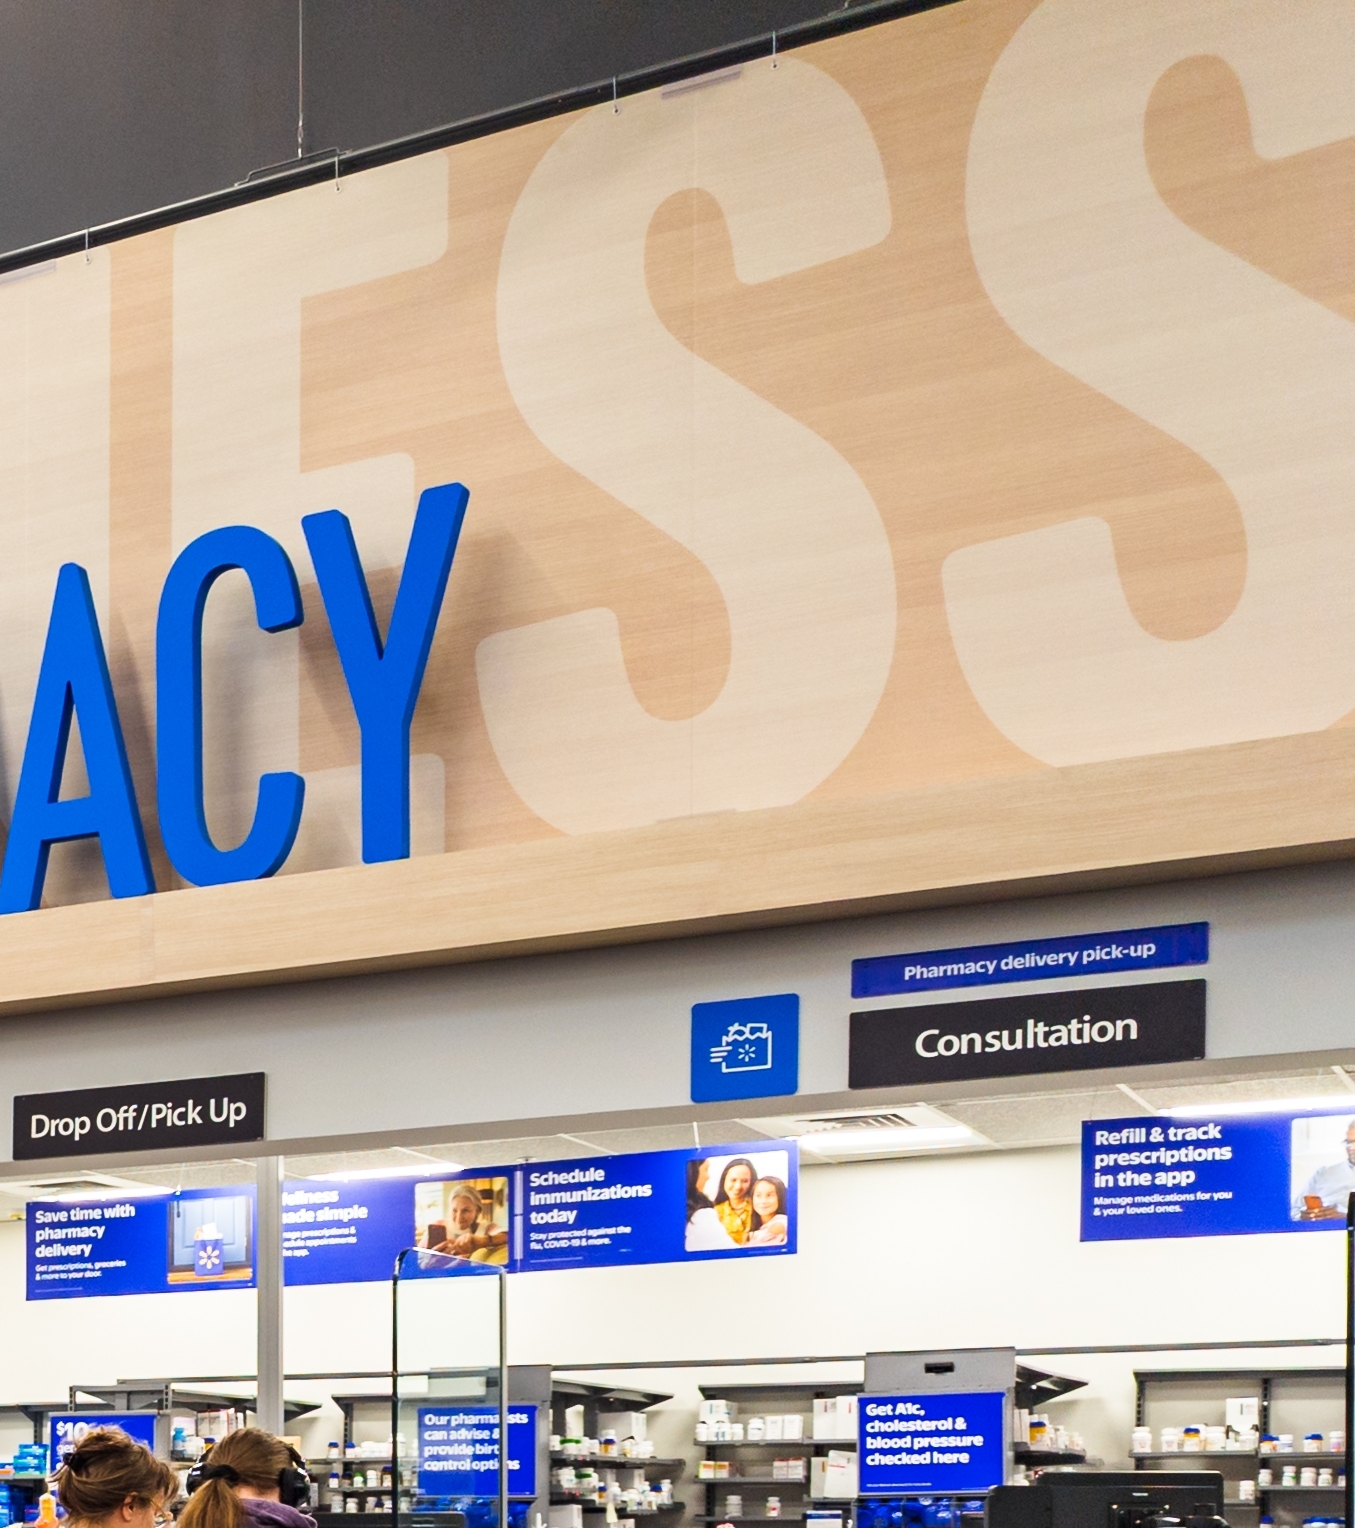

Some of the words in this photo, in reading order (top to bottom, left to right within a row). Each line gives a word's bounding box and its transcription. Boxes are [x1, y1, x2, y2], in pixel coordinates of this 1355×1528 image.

[904, 961, 997, 980] Pharmacy
[1001, 952, 1079, 971] delivery
[1082, 942, 1156, 962] pick-up
[915, 1015, 1138, 1058] Consultation
[30, 1114, 91, 1141] Drop
[96, 1099, 203, 1132] Off/Pick
[209, 1097, 247, 1128] Up
[1095, 1128, 1145, 1144] Refill
[1149, 1126, 1165, 1142] &
[1167, 1122, 1221, 1140] track
[1094, 1144, 1232, 1168] prescriptions
[529, 1167, 605, 1186] Schedule
[1094, 1173, 1113, 1187] in
[1117, 1171, 1152, 1186] the
[1155, 1169, 1195, 1186] app
[529, 1183, 652, 1205] immunizations
[1093, 1195, 1133, 1206] Manage
[1134, 1191, 1195, 1202] medications
[1196, 1191, 1211, 1201] for
[1212, 1191, 1232, 1201] you
[35, 1210, 68, 1222] Save
[70, 1207, 102, 1220] time
[103, 1203, 136, 1218] with
[316, 1204, 368, 1221] simple
[529, 1208, 577, 1225] today
[1093, 1207, 1101, 1216] &
[1102, 1207, 1125, 1217] your
[1126, 1204, 1154, 1214] loved
[1155, 1205, 1183, 1214] ones.
[35, 1225, 106, 1242] pharmacy
[35, 1243, 92, 1256] delivery
[865, 1403, 893, 1415] Get
[894, 1402, 925, 1417] A1c,
[424, 1413, 450, 1425] Our
[451, 1412, 529, 1426] pharmasts
[865, 1418, 953, 1432] cholesterol
[954, 1417, 967, 1430] &
[424, 1430, 447, 1440] can
[449, 1428, 491, 1439] advise
[865, 1435, 912, 1449] blood
[913, 1434, 984, 1449] pressure
[424, 1443, 473, 1457] provide
[475, 1442, 500, 1454] birt
[865, 1451, 931, 1465] checked
[932, 1450, 970, 1464] here
[424, 1459, 470, 1470] control
[472, 1458, 520, 1471] optins
